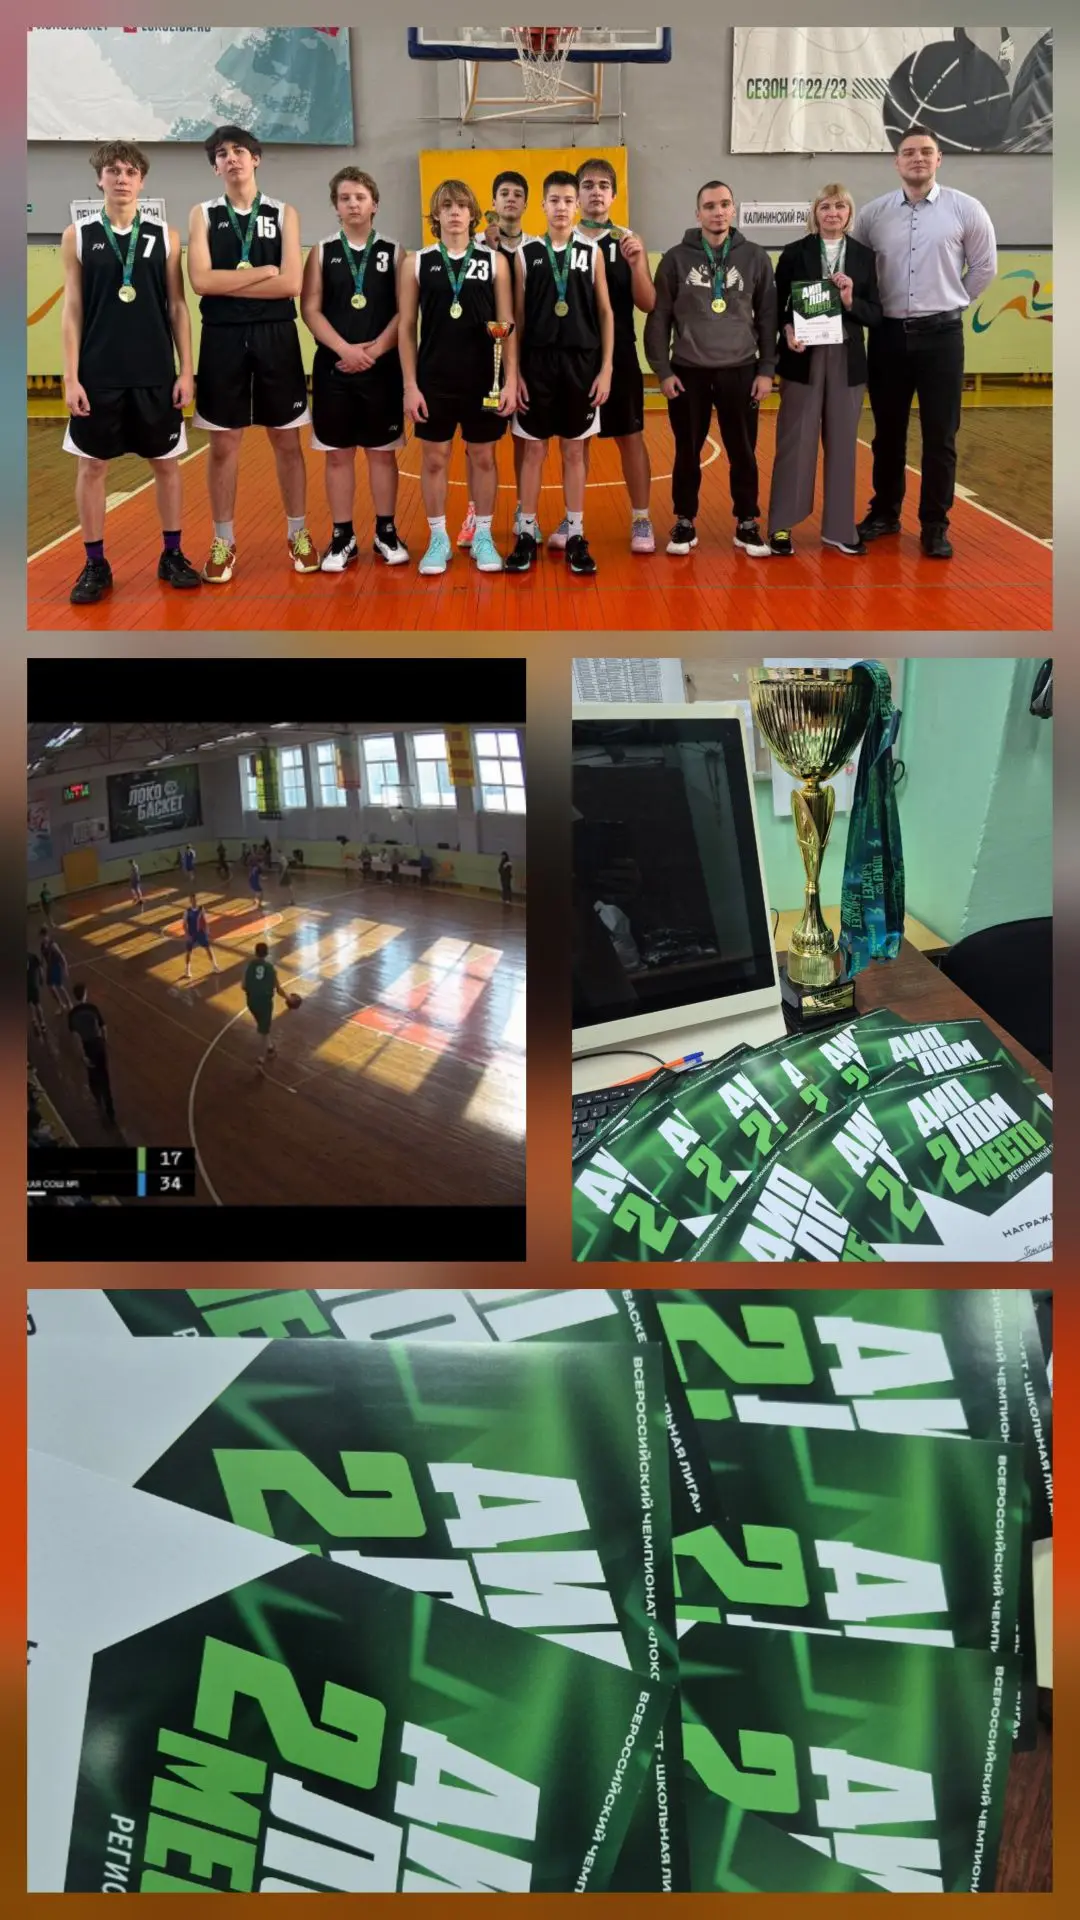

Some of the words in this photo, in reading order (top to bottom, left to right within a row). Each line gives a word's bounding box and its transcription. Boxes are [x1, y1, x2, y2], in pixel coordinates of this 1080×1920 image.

[747, 78, 787, 99] СЕЗОН
[792, 78, 847, 99] 2022/23
[143, 234, 156, 258] 7
[256, 216, 276, 239] 15
[744, 209, 795, 224] КАЛИНИНСКИЙ
[796, 209, 811, 223] РАЙ
[376, 251, 389, 272] 3
[465, 259, 489, 281] 23
[570, 248, 589, 272] 14
[609, 243, 616, 262] 1
[128, 784, 162, 806] ЛОКО
[137, 794, 184, 821] БАСКЕТ
[256, 965, 265, 980] 9
[888, 1027, 947, 1062] ДИП
[916, 1039, 983, 1076] ЛОМ
[907, 1078, 977, 1138] ДИП
[944, 1092, 1022, 1156] ЛОМ
[686, 1144, 738, 1203] 2
[926, 1133, 977, 1194] 2
[965, 1119, 1046, 1188] МЕСТО
[613, 1192, 679, 1254] 2
[739, 1162, 812, 1262] ДИП
[866, 1165, 925, 1233] 2
[656, 1303, 815, 1385] 2
[633, 1356, 654, 1509] ВСЕРОССИЙСКИЙ
[664, 1396, 685, 1459] ЛЬНАЯ
[679, 1461, 702, 1514] ЛИГА»
[1024, 1381, 1051, 1471] ШКОЛЬНАЯ
[212, 1449, 428, 1537] 2
[993, 1455, 1008, 1598] ВСЕРОССИЙСКИЙ
[641, 1513, 657, 1620] ЧЕМПИОНАТ
[193, 1635, 387, 1790] 2
[979, 1666, 1005, 1806] ВСЕРОССИЙСКИЙ
[592, 1691, 650, 1843] ВСЕРОССИЙСКИЙ
[139, 1727, 268, 1893] МЕ
[655, 1764, 672, 1860] ШКОЛЬНАЯ
[661, 1861, 672, 1893] ЛИ
[970, 1809, 989, 1893] ЧЕМПИОН
